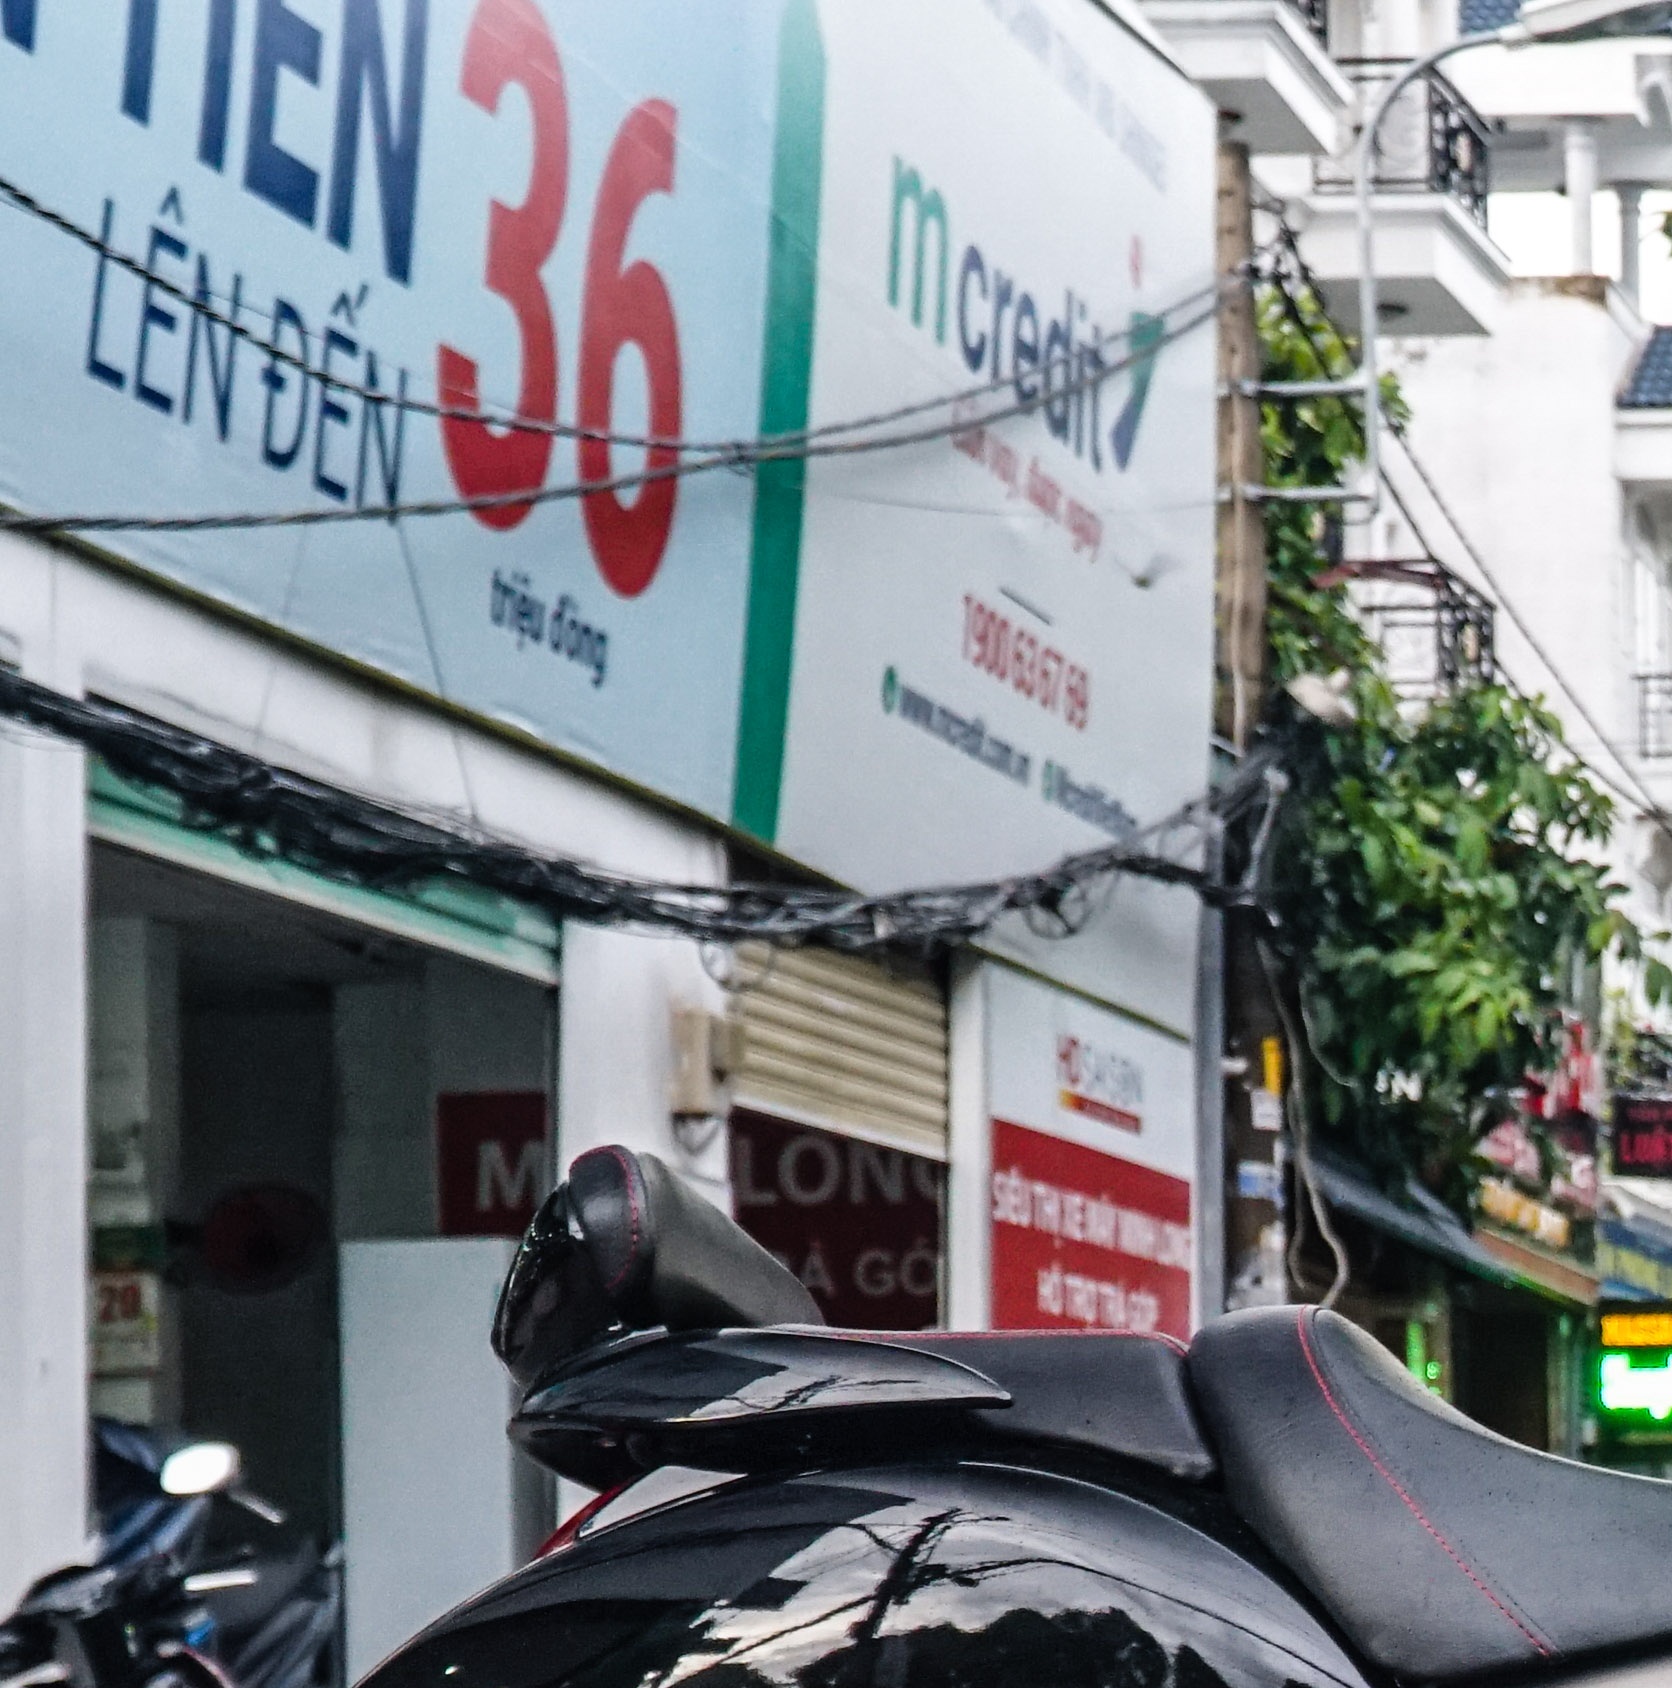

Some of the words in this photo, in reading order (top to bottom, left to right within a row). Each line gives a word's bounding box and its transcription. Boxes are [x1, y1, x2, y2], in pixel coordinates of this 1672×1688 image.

[84, 186, 243, 443] LÊN
[259, 283, 408, 524] ĐẾN
[436, 0, 683, 601] 36
[887, 153, 1102, 474] mcredit
